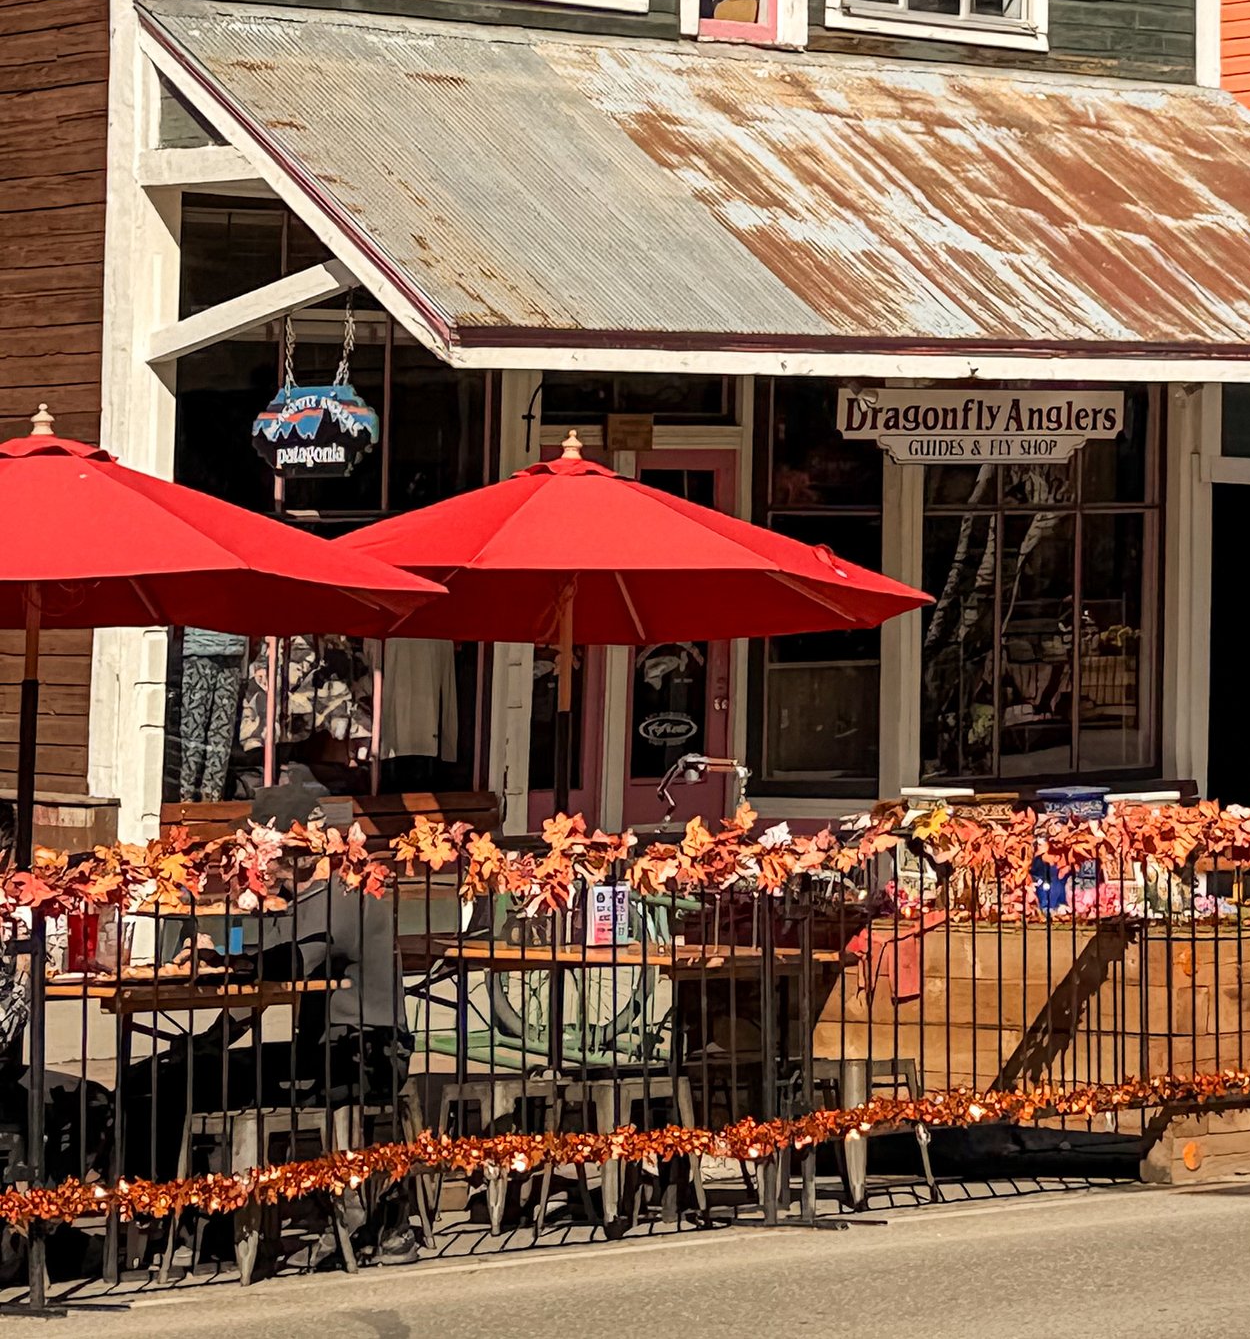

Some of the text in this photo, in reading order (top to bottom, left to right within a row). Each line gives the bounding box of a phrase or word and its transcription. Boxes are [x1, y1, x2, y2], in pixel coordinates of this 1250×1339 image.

[845, 398, 1117, 432] Dragonfly Anglers
[276, 442, 346, 468] patagonia
[908, 439, 1058, 456] GUIDES & FLY SHOP
